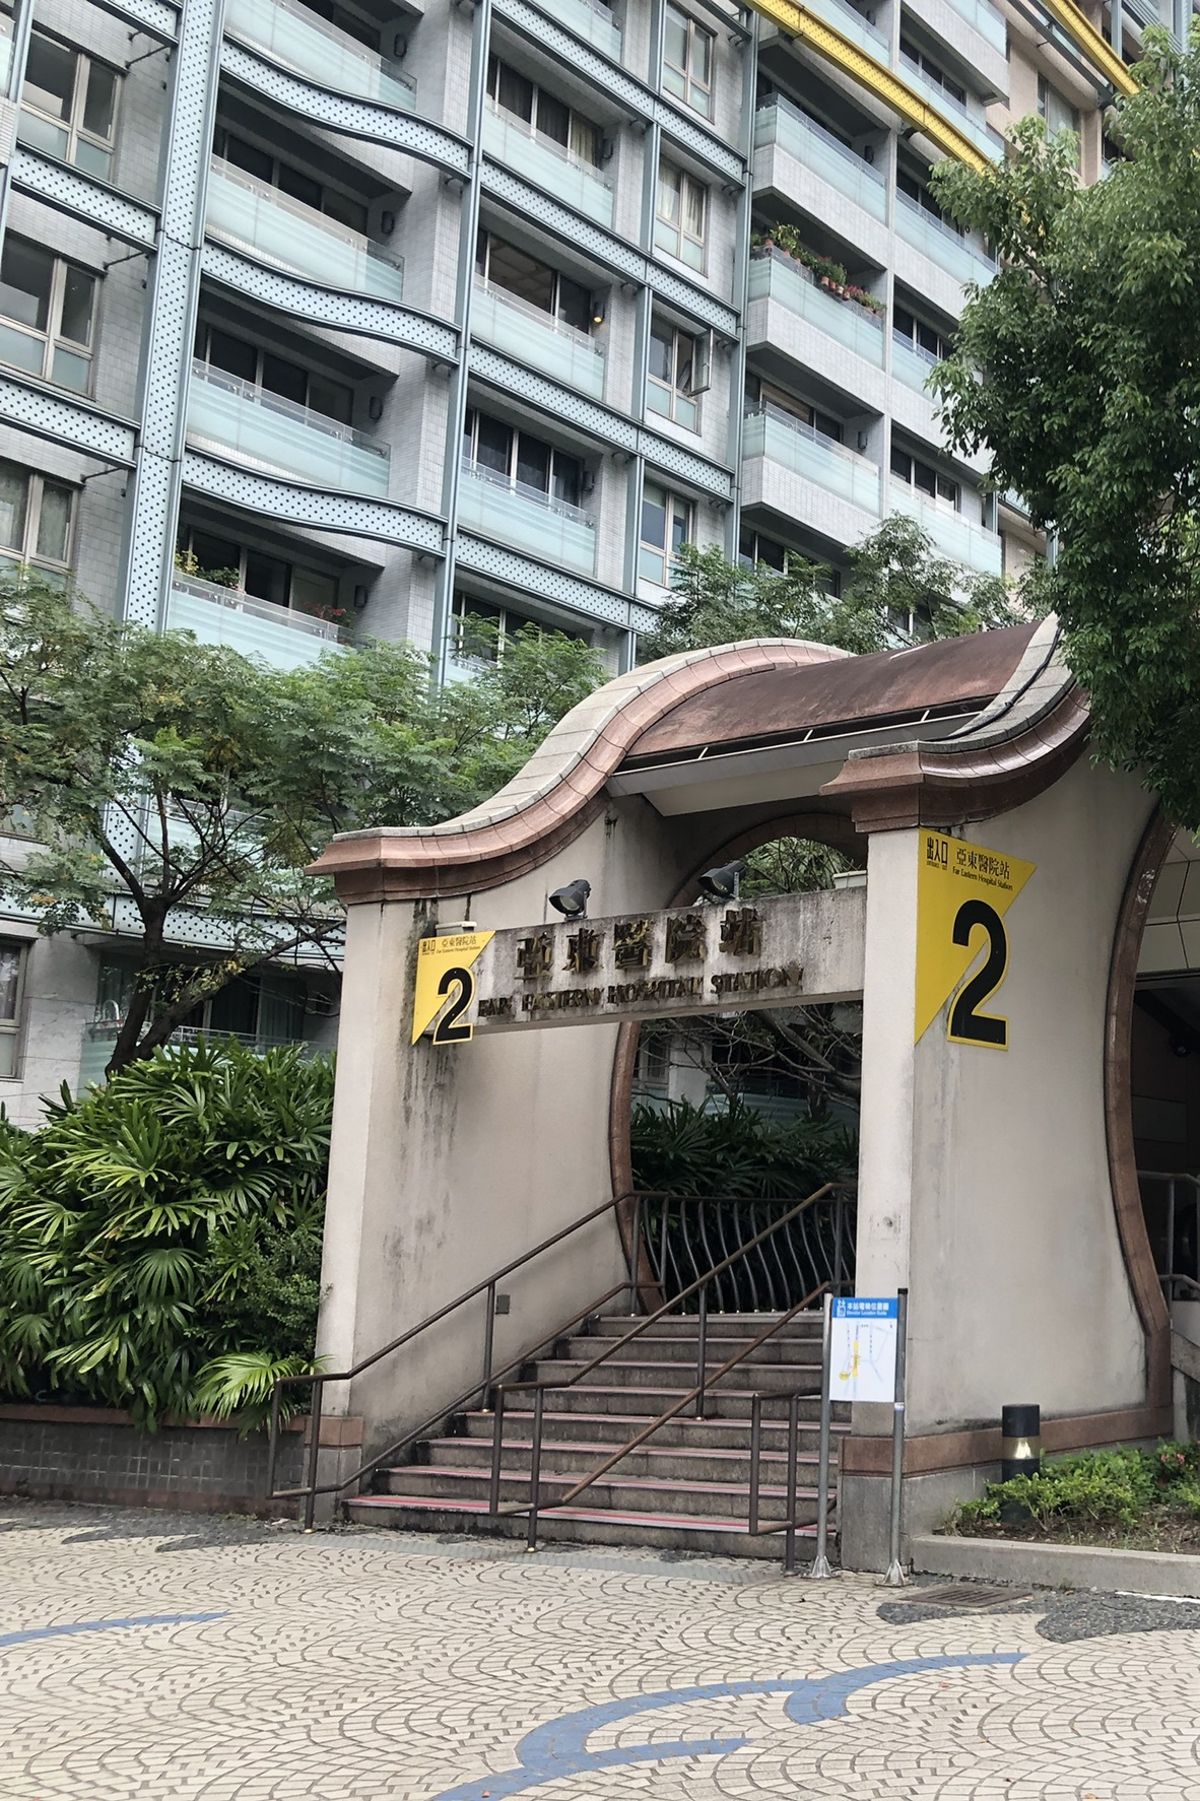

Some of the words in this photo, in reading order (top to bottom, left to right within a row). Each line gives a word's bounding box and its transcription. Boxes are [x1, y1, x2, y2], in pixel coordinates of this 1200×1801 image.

[926, 836, 948, 864] 出入口
[956, 848, 1010, 880] 亞東醫院站
[952, 866, 960, 875] Far
[961, 868, 977, 880] Eastern
[979, 875, 996, 886] Hospital
[997, 880, 1013, 891] Station
[514, 907, 765, 983] 亞東醫院站
[521, 986, 605, 1012] EASTERN
[607, 976, 704, 1004] HOSPITAL
[710, 965, 804, 994] STATION
[950, 899, 1007, 1045] 2
[435, 967, 473, 1042] 2
